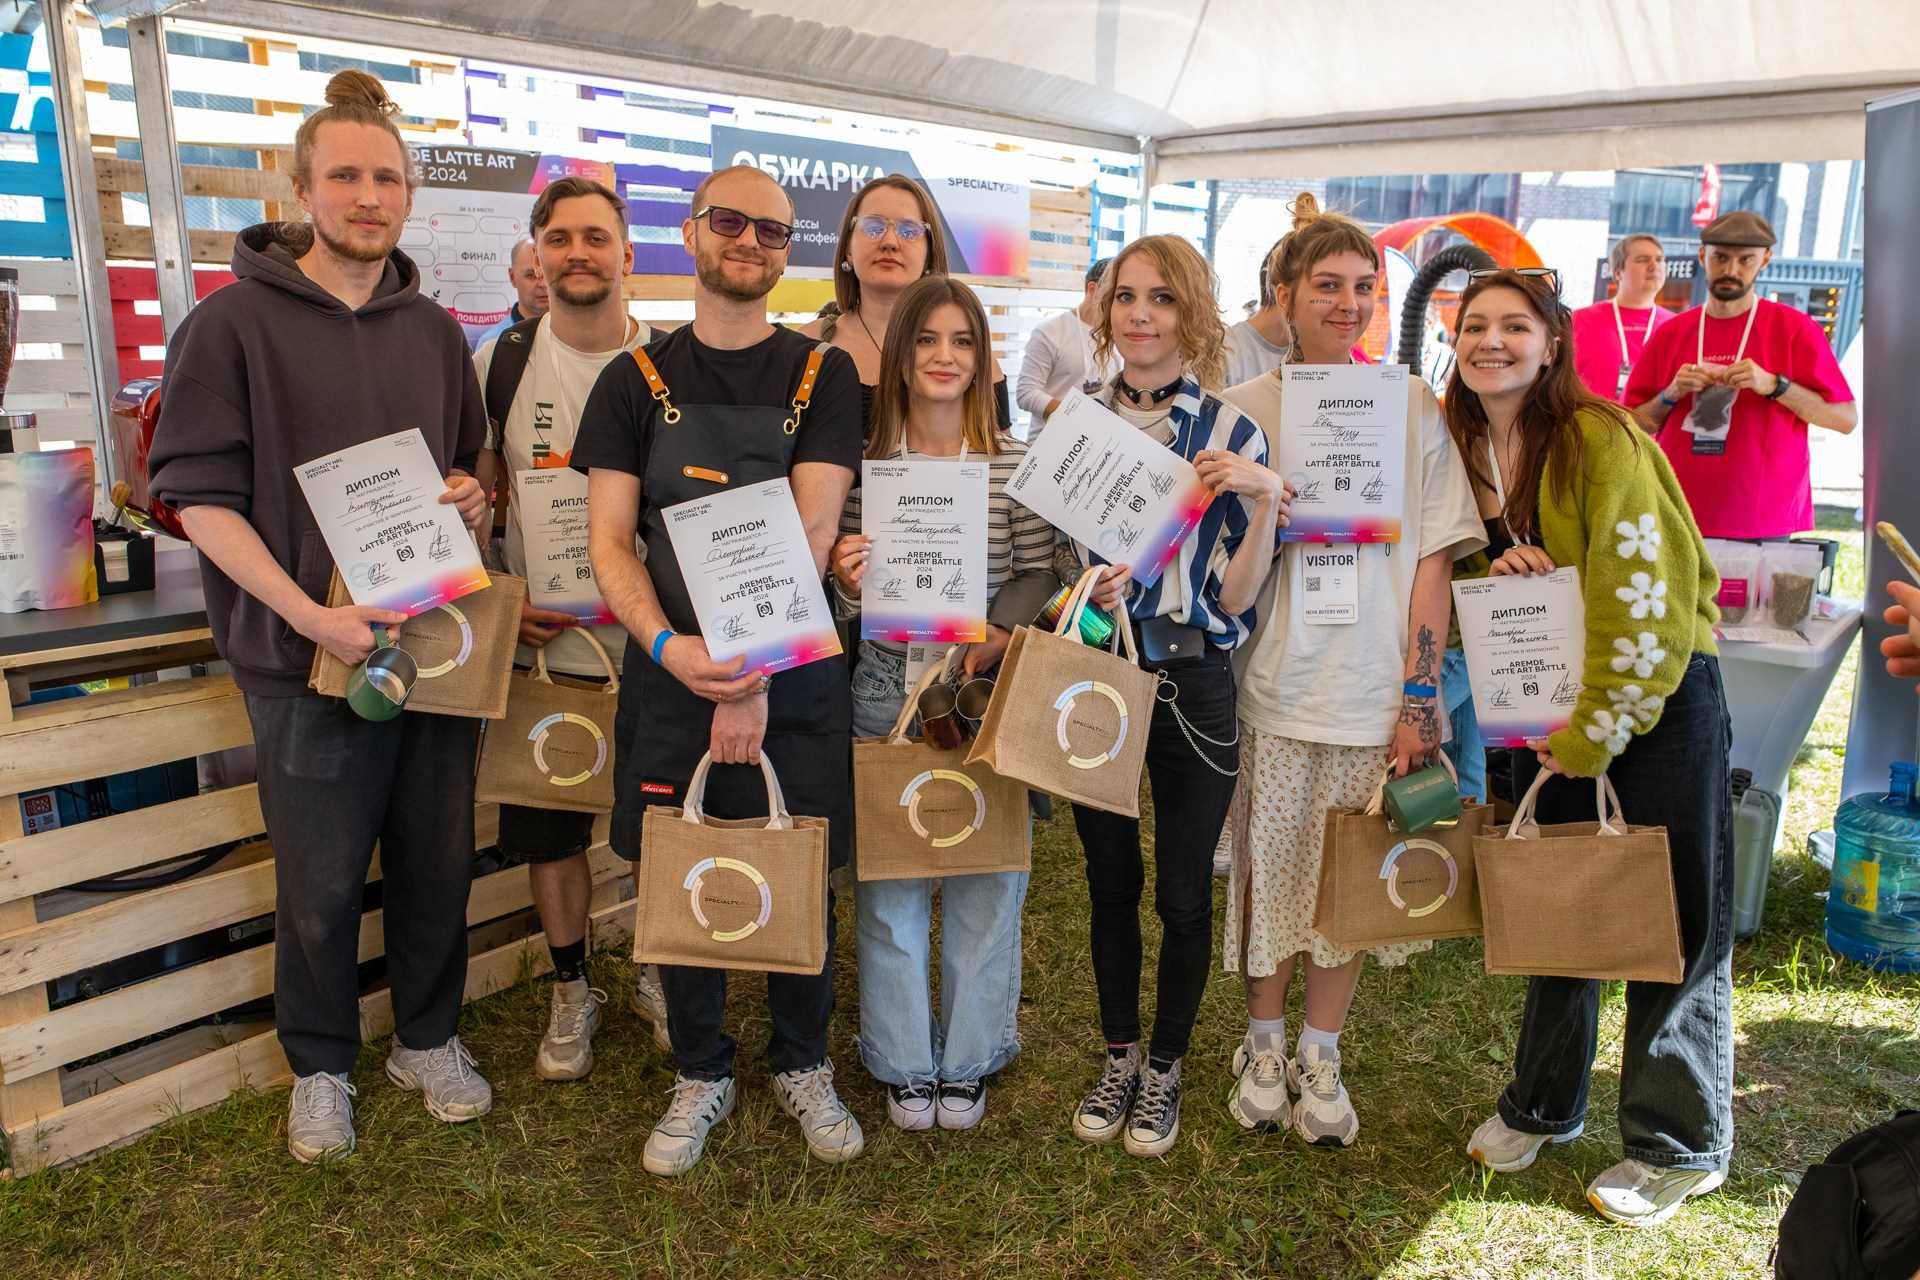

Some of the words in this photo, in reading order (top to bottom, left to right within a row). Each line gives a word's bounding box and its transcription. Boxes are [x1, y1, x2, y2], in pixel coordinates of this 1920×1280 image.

[435, 150, 483, 167] LATTE
[487, 154, 516, 169] ART
[428, 167, 468, 182] 2024
[948, 177, 1019, 195] SPECIALTY.RU
[794, 219, 819, 229] ассы
[461, 251, 496, 261] ФИНАЛ
[1318, 399, 1373, 410] ДИПЛОМ
[1053, 434, 1088, 485] ДИПЛОМ
[305, 462, 331, 475] SPECIALTY
[307, 468, 331, 479] FESTIVAL
[345, 468, 400, 496] ДИПЛОМ
[1097, 502, 1116, 525] LATTE
[1113, 486, 1125, 503] ART
[1123, 460, 1144, 488] BATTLE
[1104, 473, 1127, 505] AREMDE
[551, 497, 589, 509] ДИПЛО
[898, 496, 953, 506] ДИПЛОМ
[1121, 490, 1133, 505] 2024
[673, 506, 700, 517] SPECIALTY
[674, 512, 699, 522] FESTIVAL
[359, 538, 386, 553] LATTE
[387, 531, 402, 542] ART
[404, 519, 435, 535] BATTLE
[378, 520, 412, 539] AREMDE
[712, 519, 766, 543] ДИПЛОМ
[392, 538, 409, 547] 2024
[548, 553, 570, 561] LATTE
[1306, 555, 1354, 566] VISITOR
[739, 575, 774, 591] AREMDE
[720, 590, 747, 603] LATTE
[748, 585, 763, 595] ART
[765, 577, 795, 590] BATTLE
[753, 593, 769, 602] 2024
[1491, 605, 1546, 620] ДИПЛОМ
[1509, 659, 1544, 668] AREMDE
[1517, 666, 1533, 674] ART
[1535, 664, 1567, 672] BATTLE
